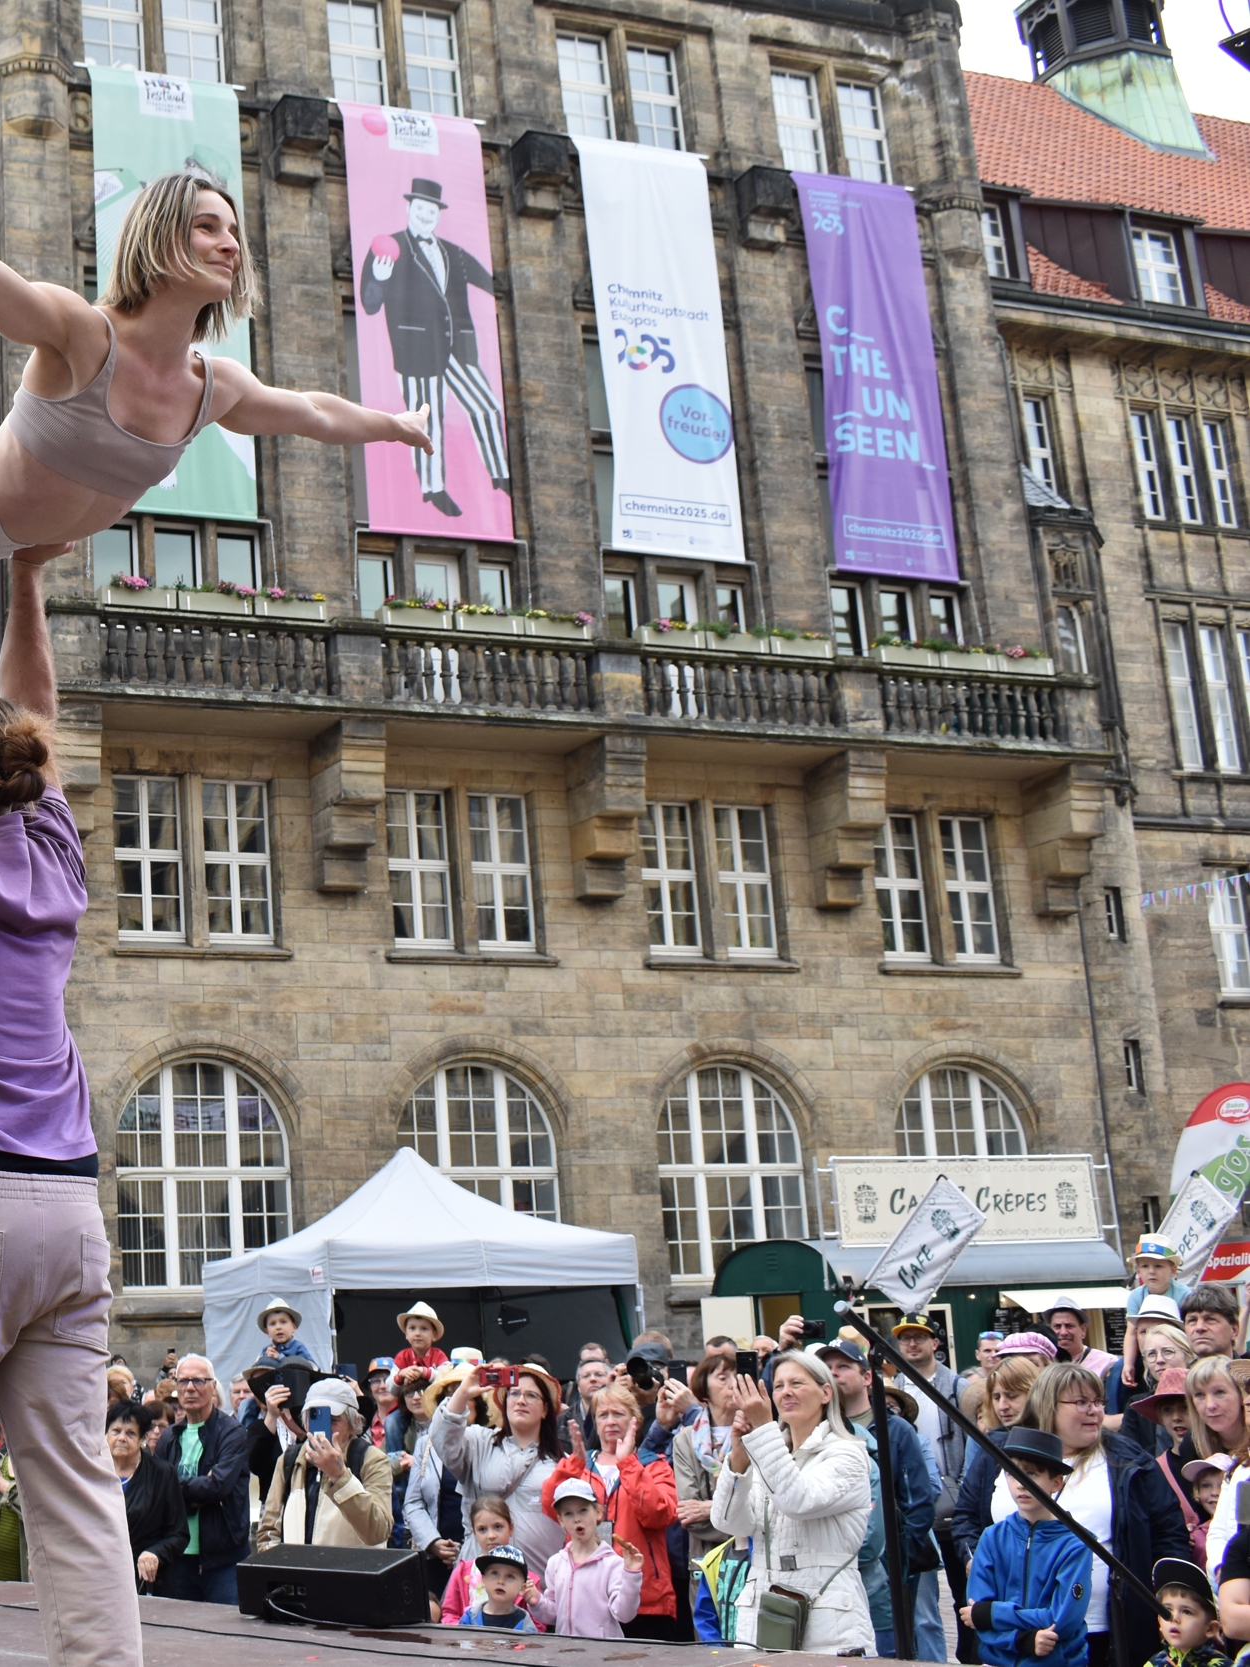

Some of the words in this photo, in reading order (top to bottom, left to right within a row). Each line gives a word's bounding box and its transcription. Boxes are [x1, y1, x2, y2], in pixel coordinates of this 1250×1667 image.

[829, 343, 891, 380] THE
[680, 404, 714, 422] Vor-
[667, 415, 726, 442] freude!
[625, 500, 727, 521] chemnitz2025.de
[848, 522, 942, 543] chemnitz2025.de
